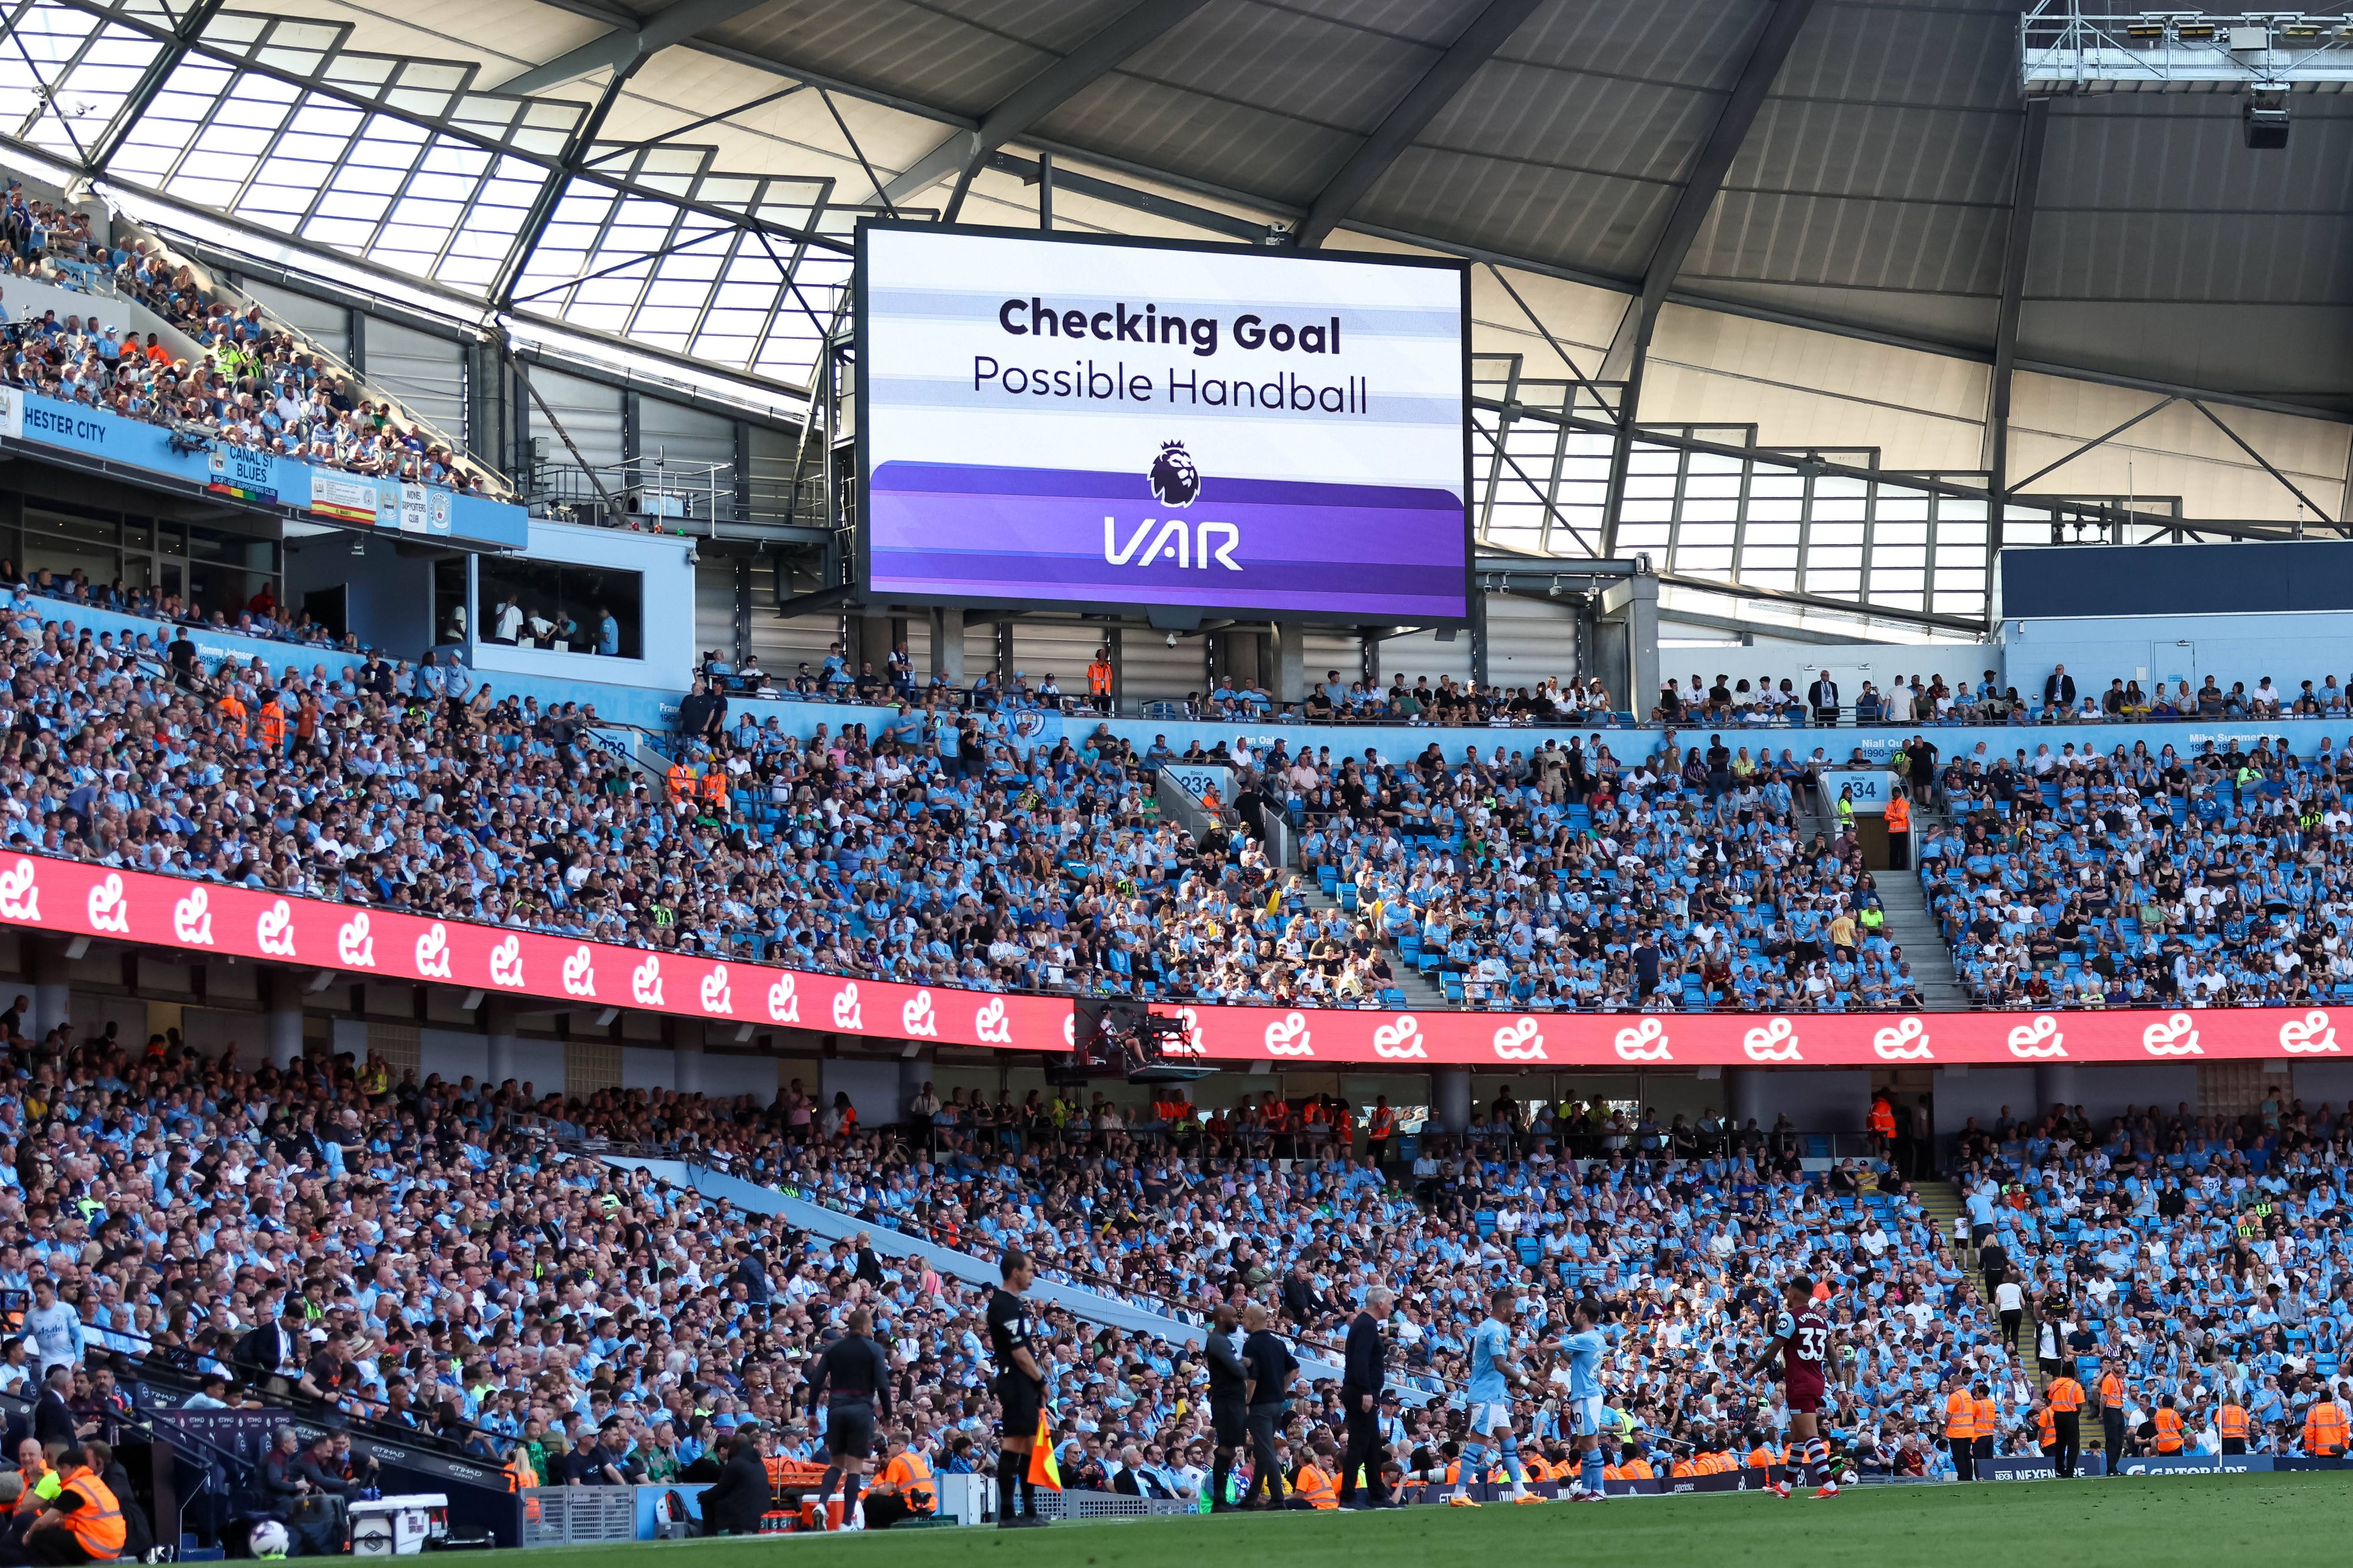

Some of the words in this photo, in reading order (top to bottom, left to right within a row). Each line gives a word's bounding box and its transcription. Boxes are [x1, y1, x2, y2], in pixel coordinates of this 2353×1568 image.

[999, 297, 1218, 355] Checking
[1233, 313, 1340, 354] Goal
[974, 355, 1153, 402] Possible
[1169, 368, 1367, 414] Handball
[23, 406, 73, 435] HESTER
[77, 421, 106, 443] CITY
[230, 446, 260, 466] CANAL
[263, 454, 273, 468] ST
[237, 463, 266, 483] BLUES
[1104, 516, 1244, 571] VAR
[198, 643, 224, 656] Tommy
[1862, 739, 1885, 748] Niall
[2189, 733, 2214, 743] Mike
[1798, 1312, 1824, 1325] EMERSON
[1797, 1327, 1827, 1361] 33
[372, 1446, 405, 1459] ETIHAD
[449, 1464, 482, 1477] ETIHAD
[1674, 1482, 1694, 1493] experience
